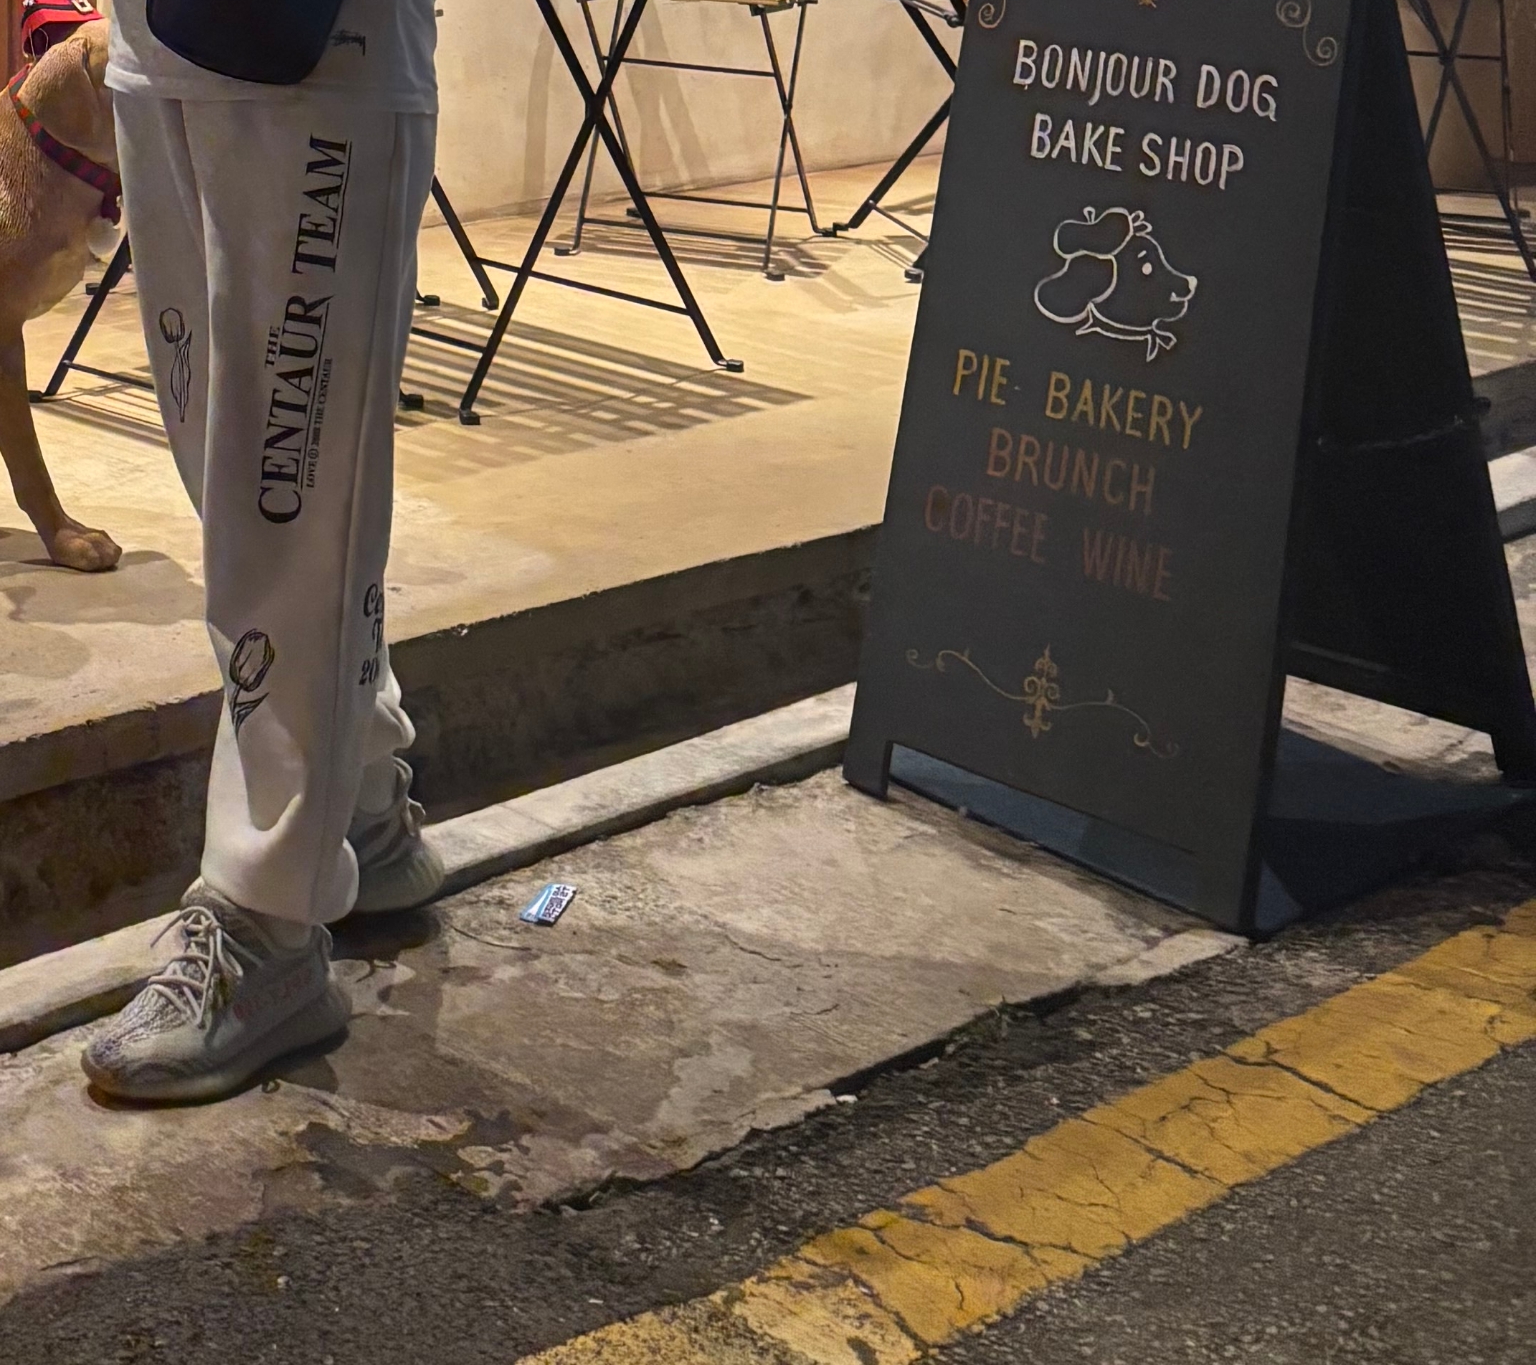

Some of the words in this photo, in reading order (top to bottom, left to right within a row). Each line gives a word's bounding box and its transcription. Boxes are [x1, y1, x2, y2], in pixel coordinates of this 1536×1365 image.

[1013, 39, 1175, 107] BONJOUR
[1196, 64, 1279, 122] DOG
[1030, 113, 1125, 172] BAKE
[1139, 132, 1244, 190] SHOP
[292, 133, 350, 275] TEAM
[265, 325, 281, 367] THE
[258, 294, 335, 525] CENTAUR
[952, 348, 1011, 406] PIE
[1045, 370, 1203, 450] BAKERY
[987, 427, 1157, 515] BRUNCH
[923, 485, 1049, 565] COFFEE
[1081, 527, 1173, 602] WINE
